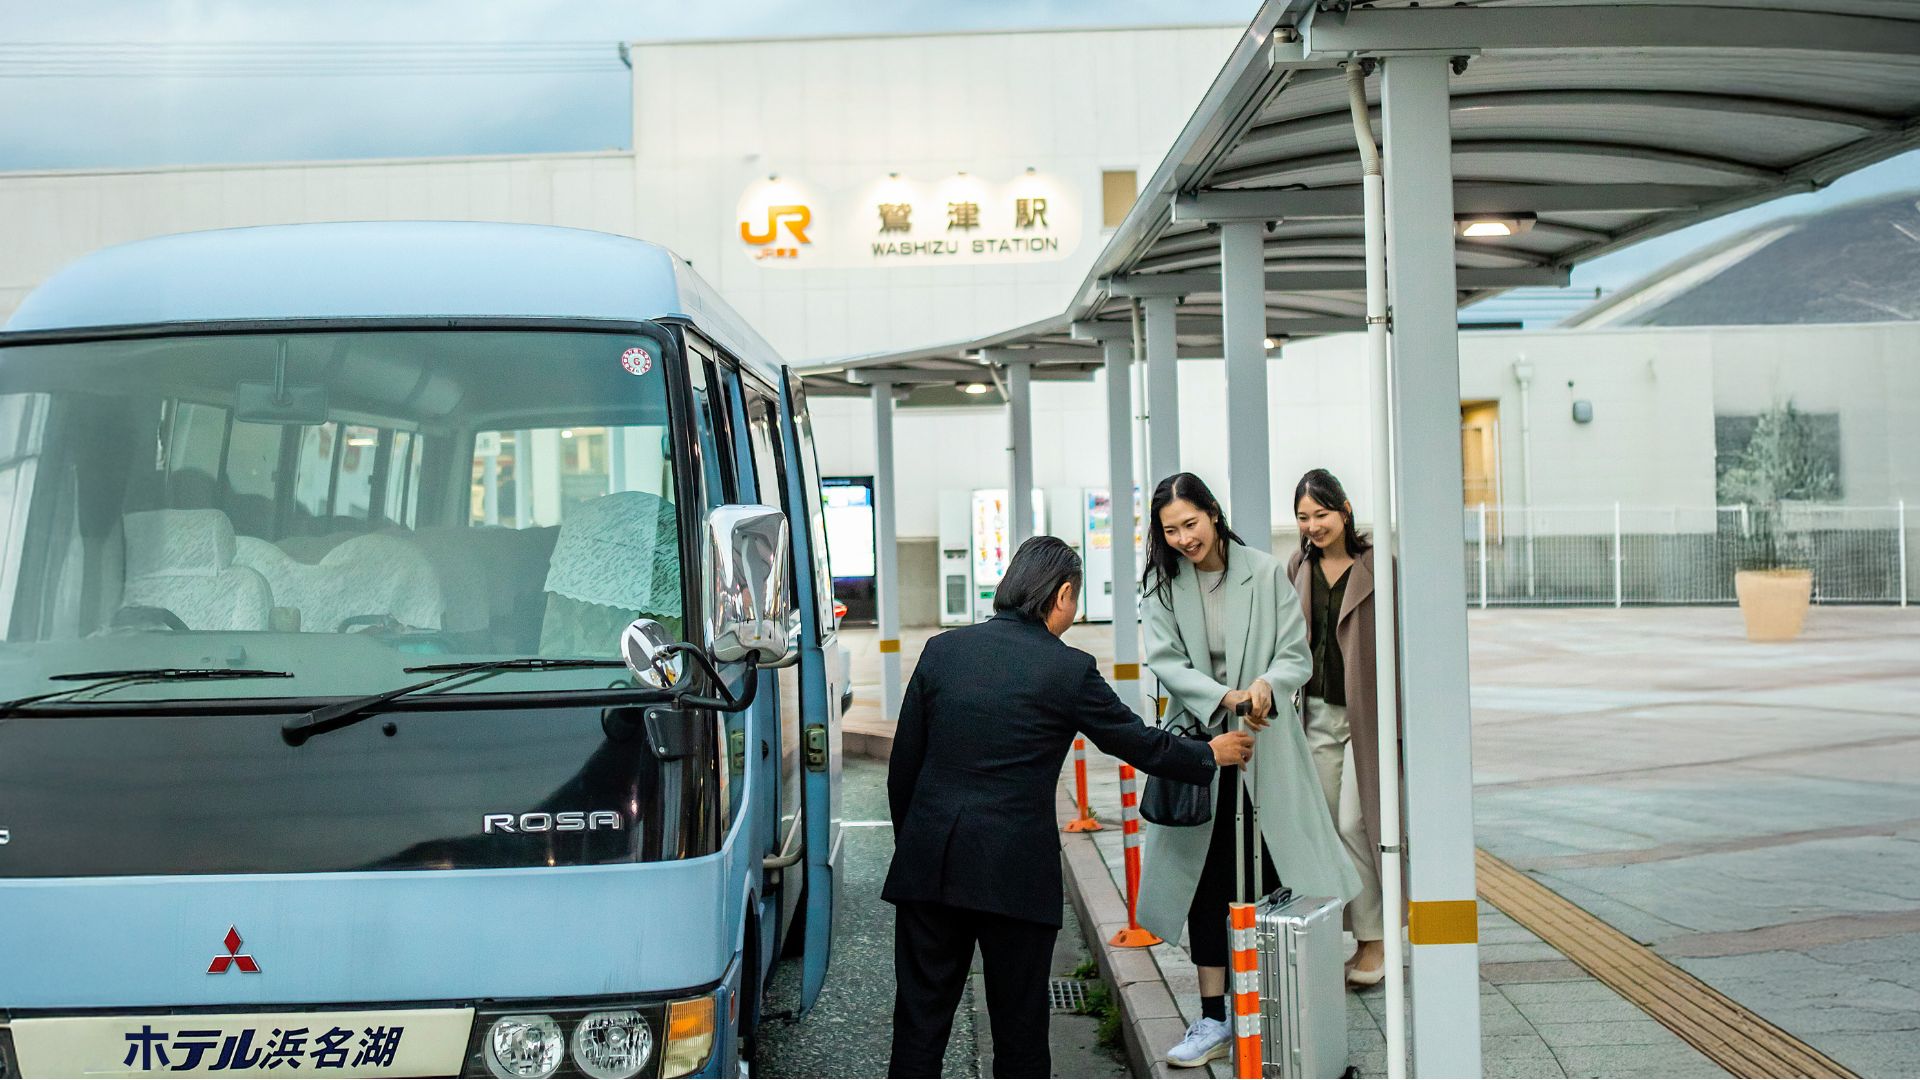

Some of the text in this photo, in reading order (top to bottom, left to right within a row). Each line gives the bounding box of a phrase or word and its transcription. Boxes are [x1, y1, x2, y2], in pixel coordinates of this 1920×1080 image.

[740, 205, 811, 244] JR
[878, 198, 1048, 233] 鷲津駅
[872, 237, 1058, 257] WASHIZU STATION
[483, 811, 621, 834] ROSA
[123, 1024, 404, 1071] ホテル浜名湖
